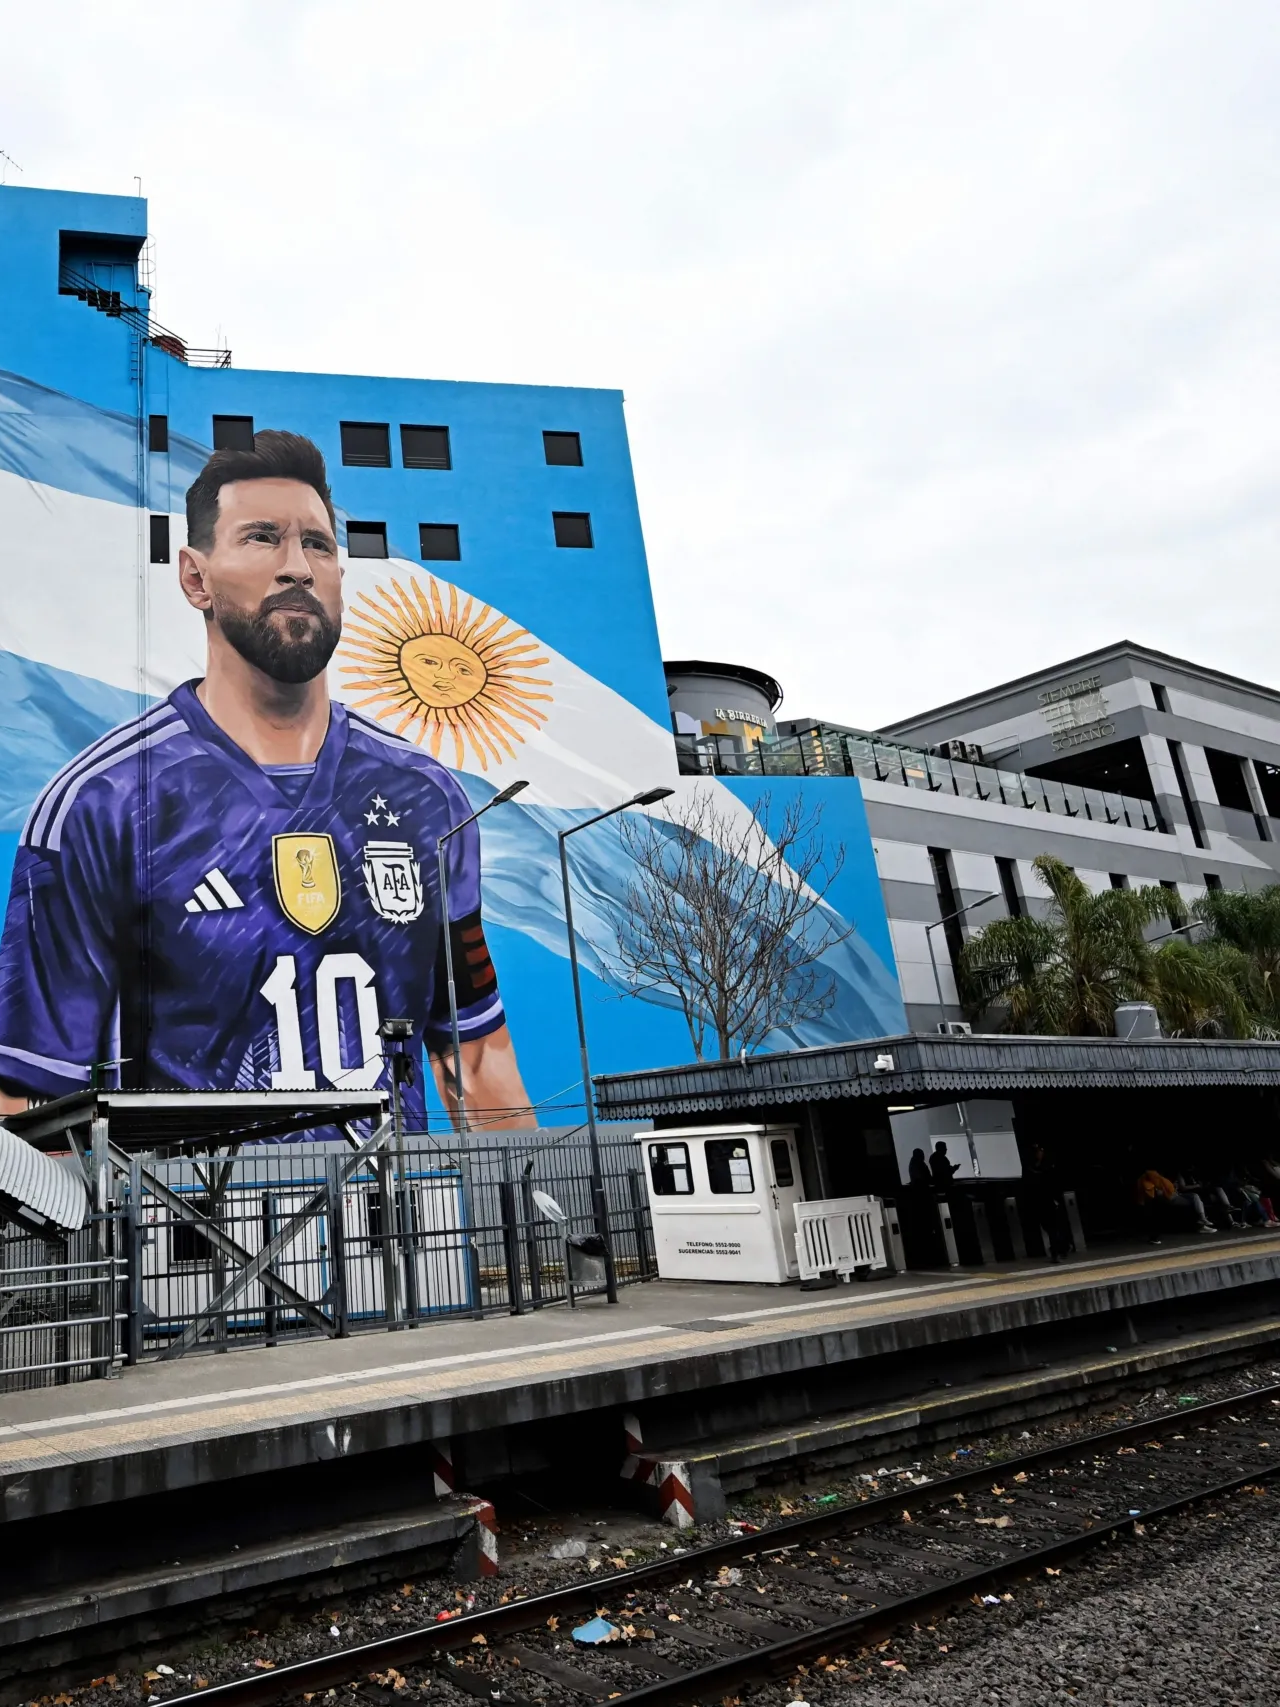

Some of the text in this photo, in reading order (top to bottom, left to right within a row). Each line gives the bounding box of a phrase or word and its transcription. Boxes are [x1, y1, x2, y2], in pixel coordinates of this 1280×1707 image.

[1037, 675, 1102, 706] SIEMPRE
[715, 708, 769, 729] LA BIRRERIA
[1050, 708, 1107, 736] NUNCA
[382, 861, 411, 903] AFA
[297, 892, 326, 905] FIFA
[260, 953, 385, 1091] 10
